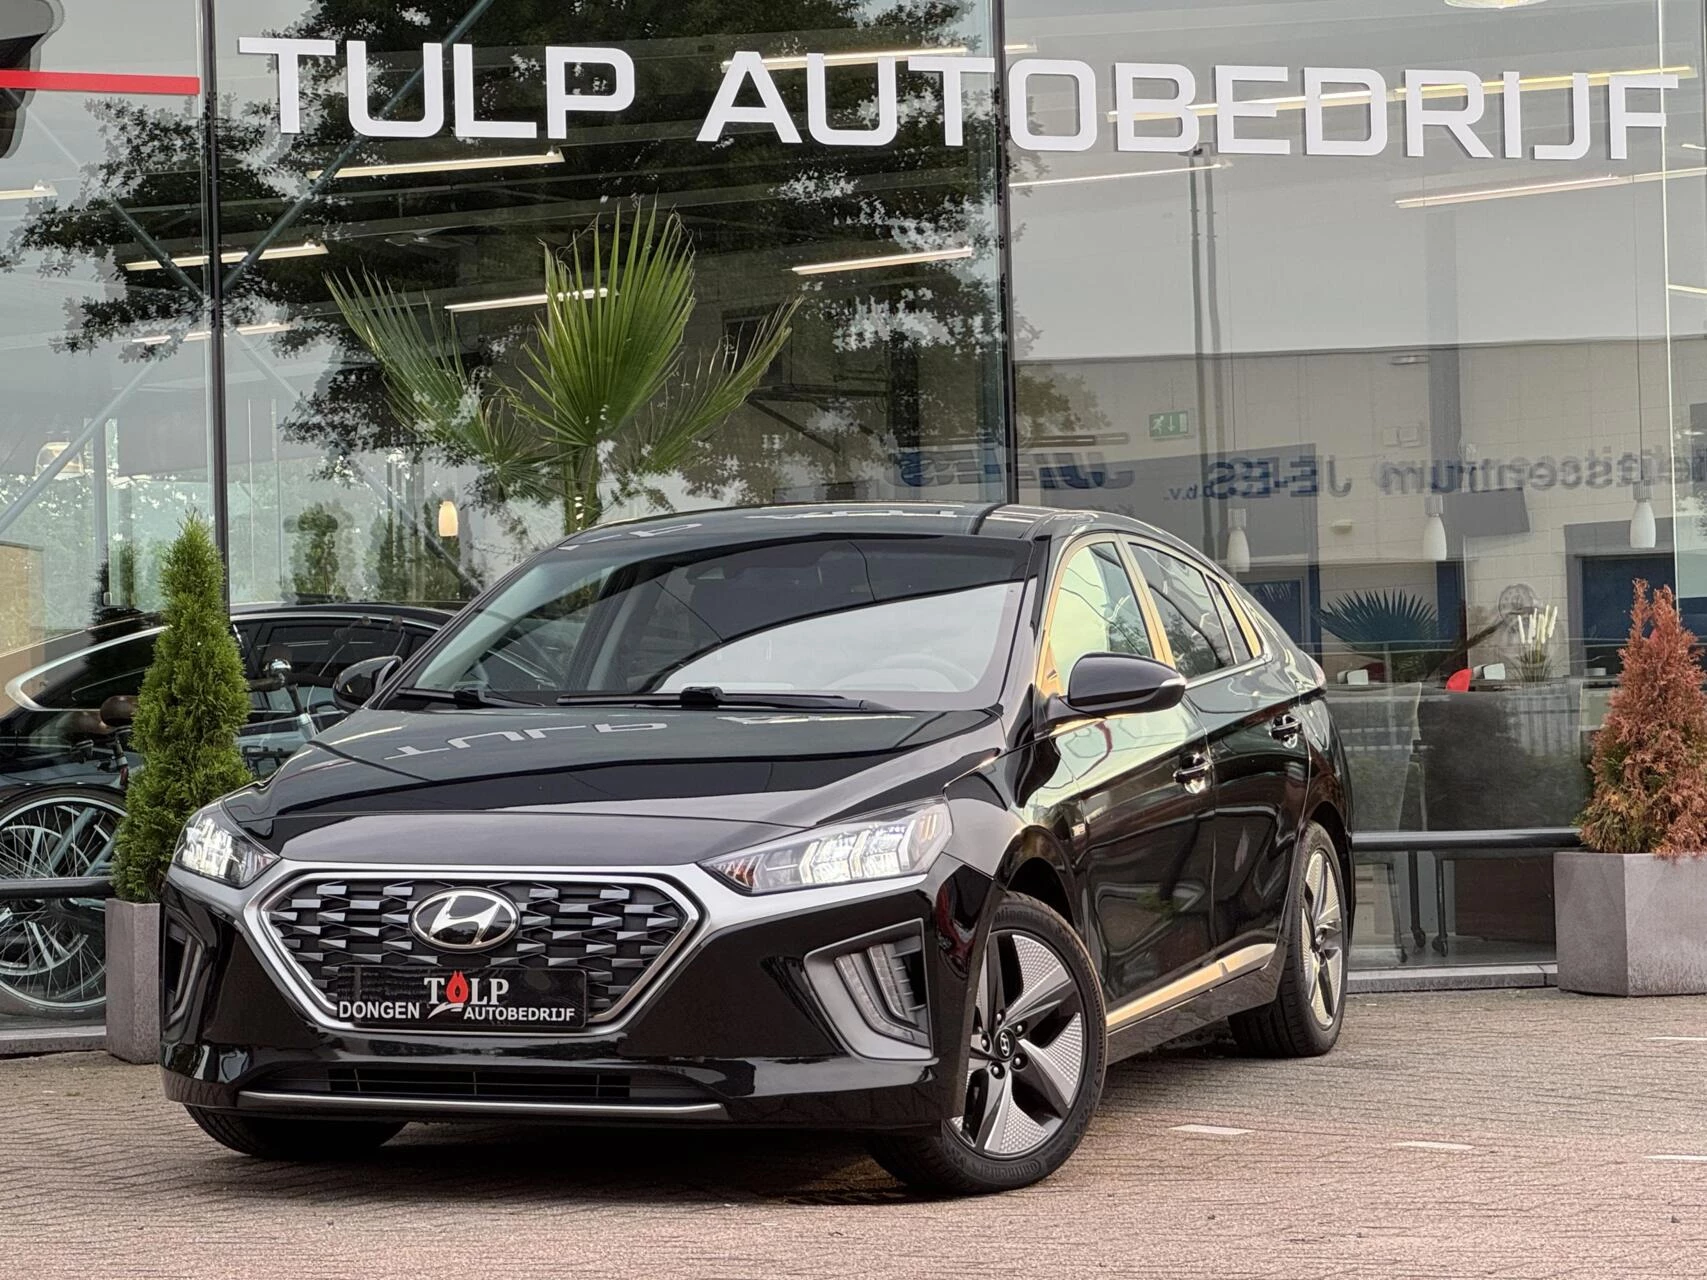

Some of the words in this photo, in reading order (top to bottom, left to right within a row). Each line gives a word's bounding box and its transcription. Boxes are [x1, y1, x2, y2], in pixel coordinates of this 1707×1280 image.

[238, 37, 636, 140] TULP
[696, 51, 1680, 160] AUTOBEDRIJF
[339, 1001, 421, 1019] DONGEN
[463, 1006, 575, 1021] AUTOBEDRIJF
